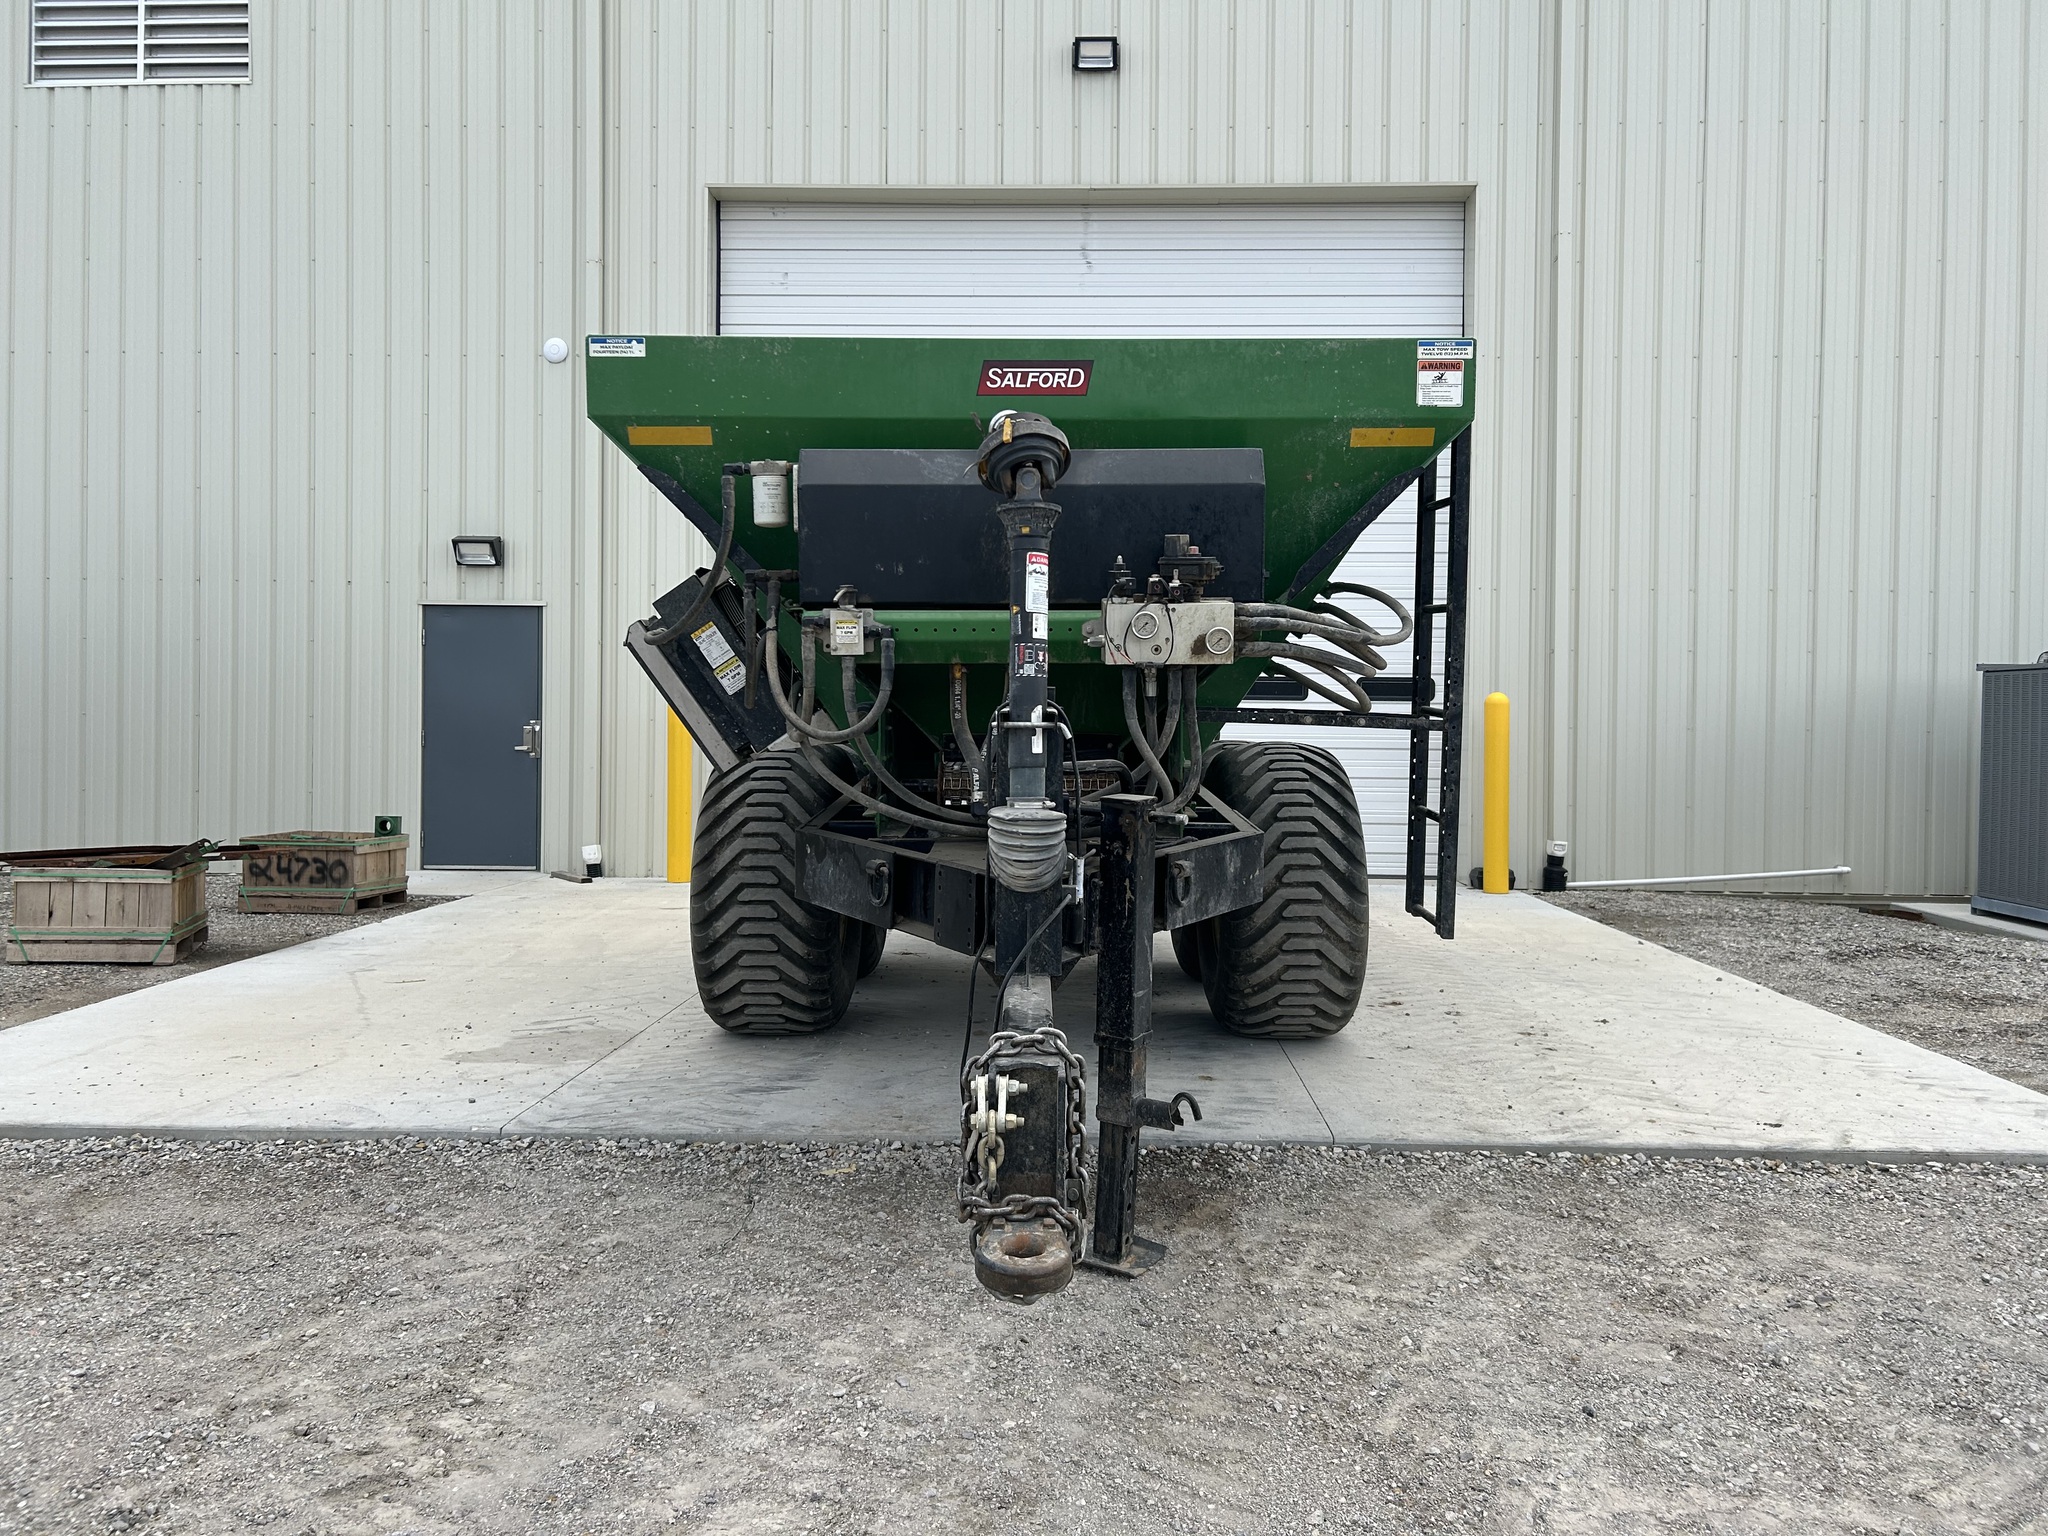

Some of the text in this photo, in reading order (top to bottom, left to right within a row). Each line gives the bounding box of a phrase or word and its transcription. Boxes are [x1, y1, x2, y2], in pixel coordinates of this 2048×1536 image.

[1428, 362, 1461, 370] WARNING
[986, 367, 1085, 388] SALFORD
[720, 664, 741, 680] MAX FLOW
[730, 671, 741, 680] GPM
[250, 853, 349, 885] 24730
